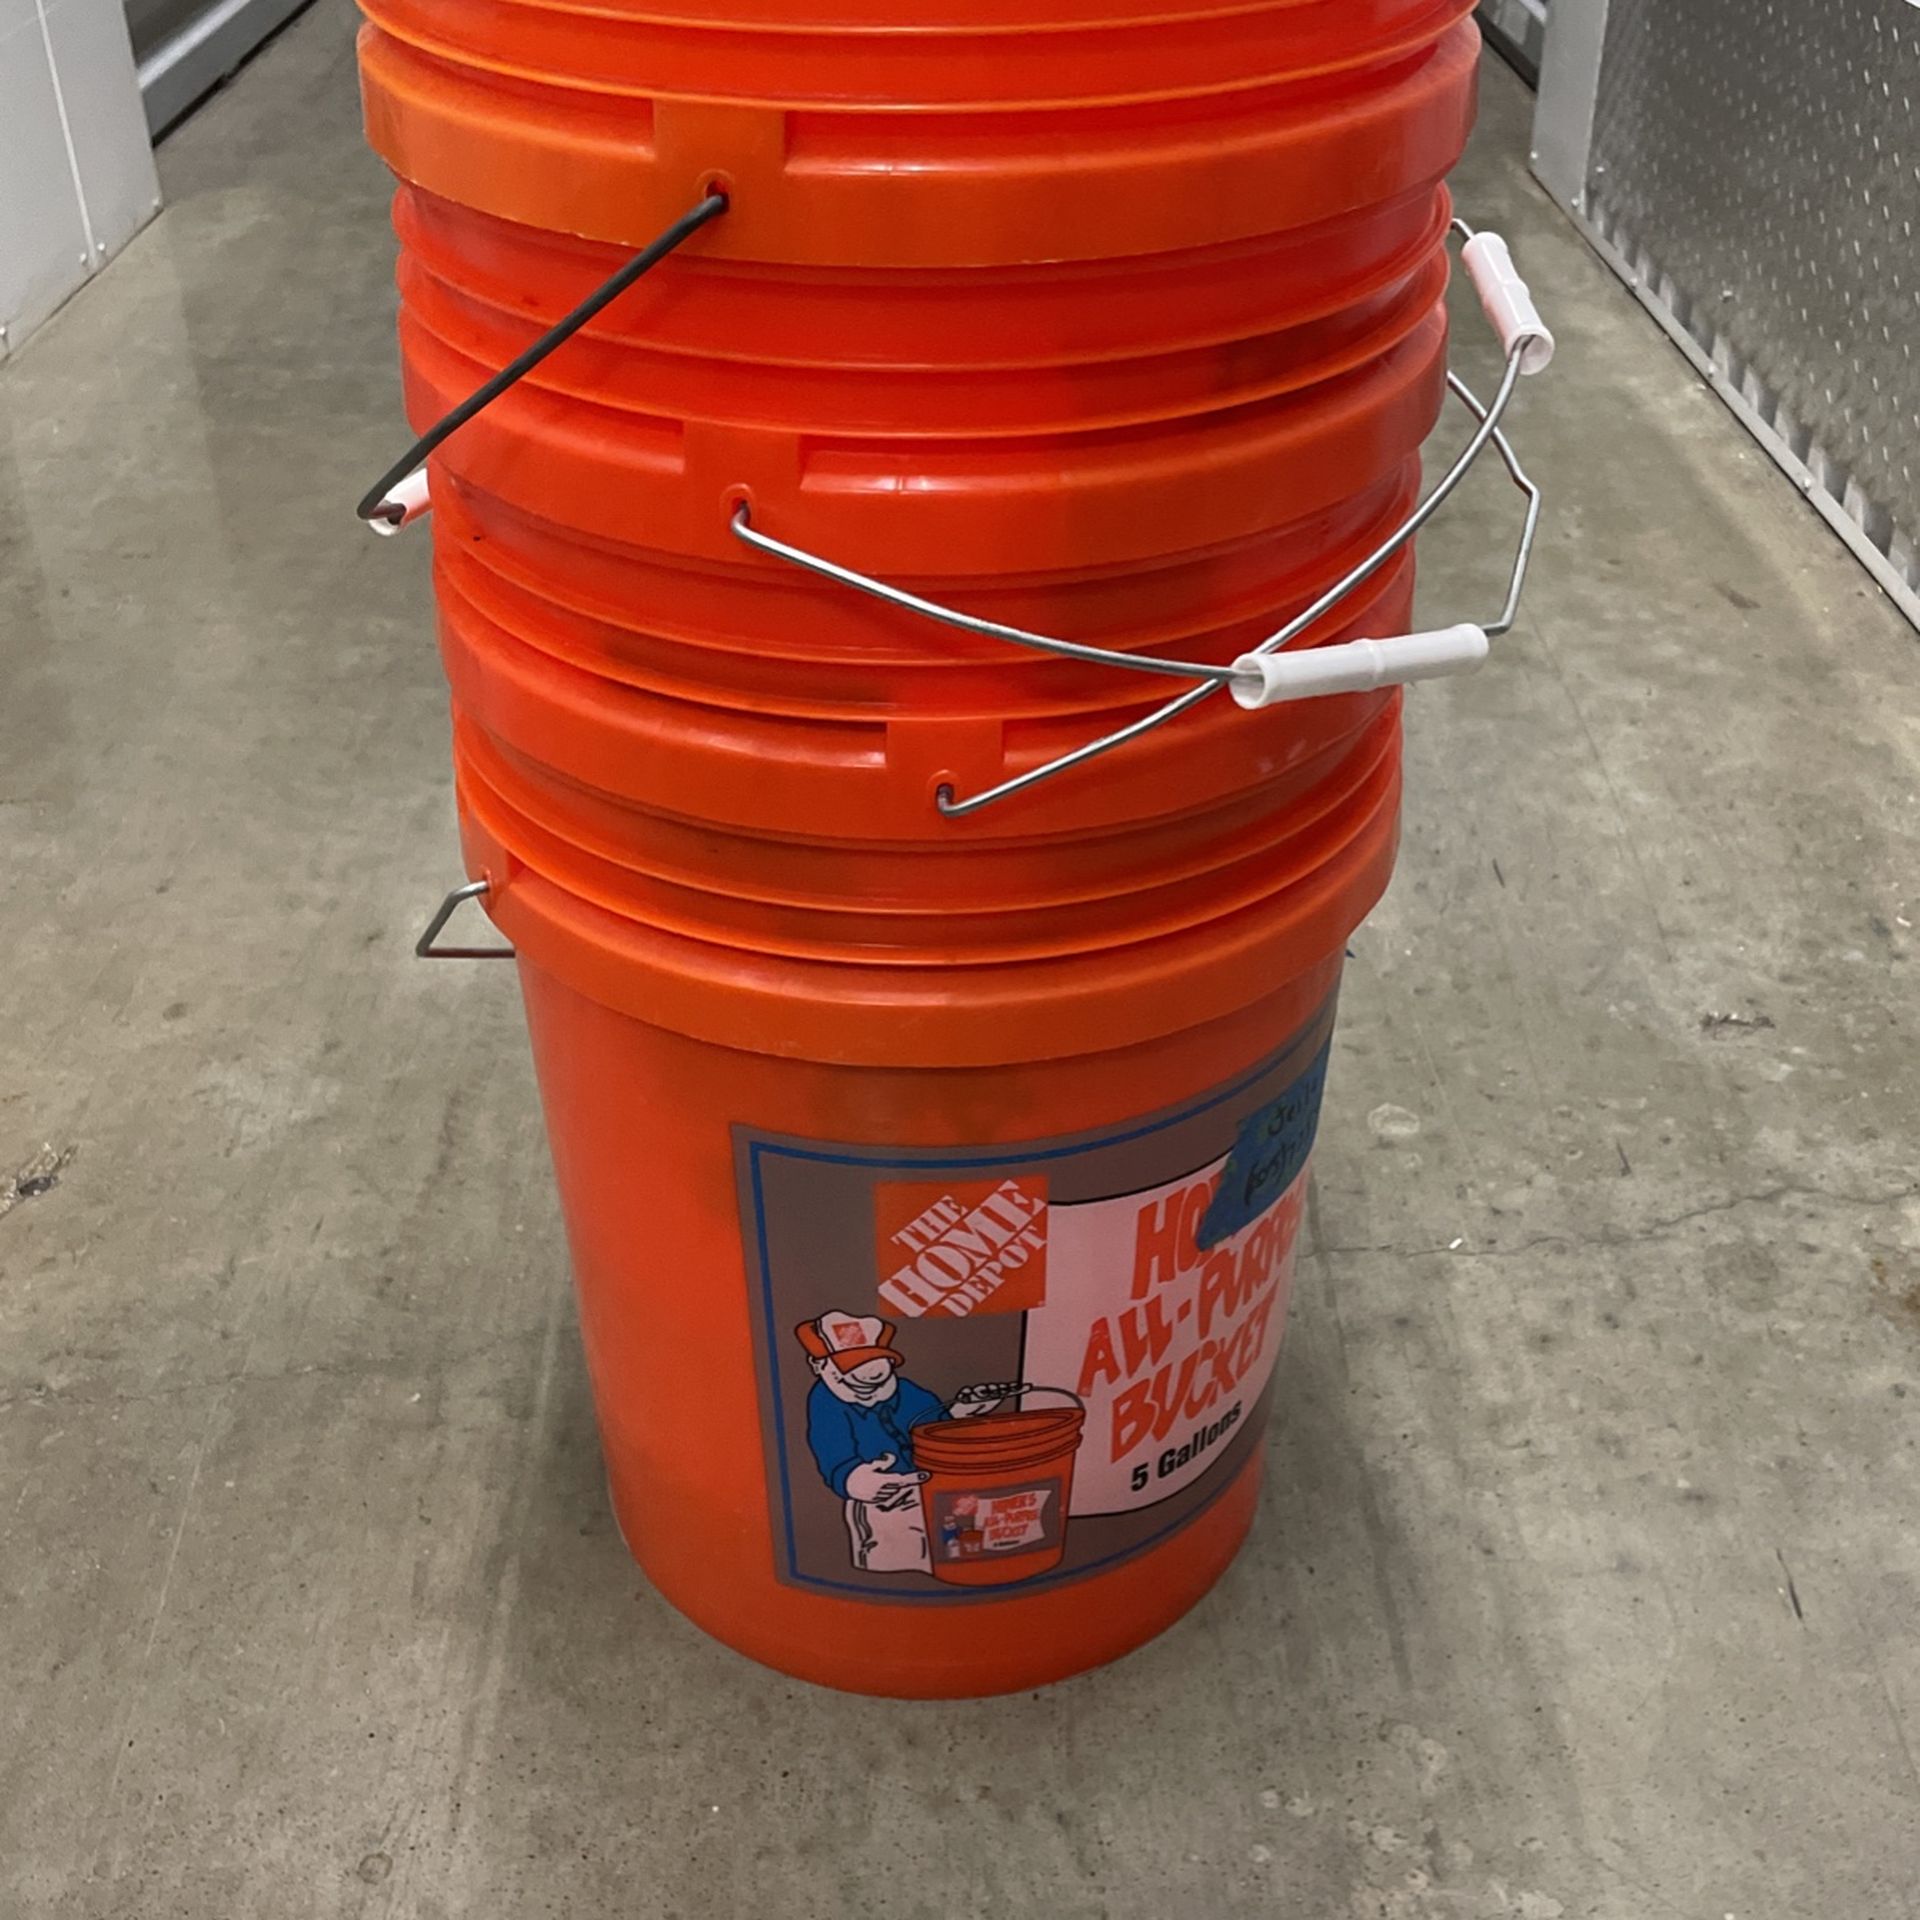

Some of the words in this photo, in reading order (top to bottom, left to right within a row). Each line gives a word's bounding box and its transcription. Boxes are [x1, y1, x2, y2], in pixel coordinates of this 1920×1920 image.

[878, 1179, 1046, 1317] HOME
[890, 1195, 968, 1252] THE
[941, 1225, 1047, 1317] DEPOT
[1131, 1171, 1222, 1299] HO
[1111, 1276, 1280, 1464] BUCKET
[1131, 1462, 1149, 1492] 5
[1157, 1401, 1242, 1479] Gallons
